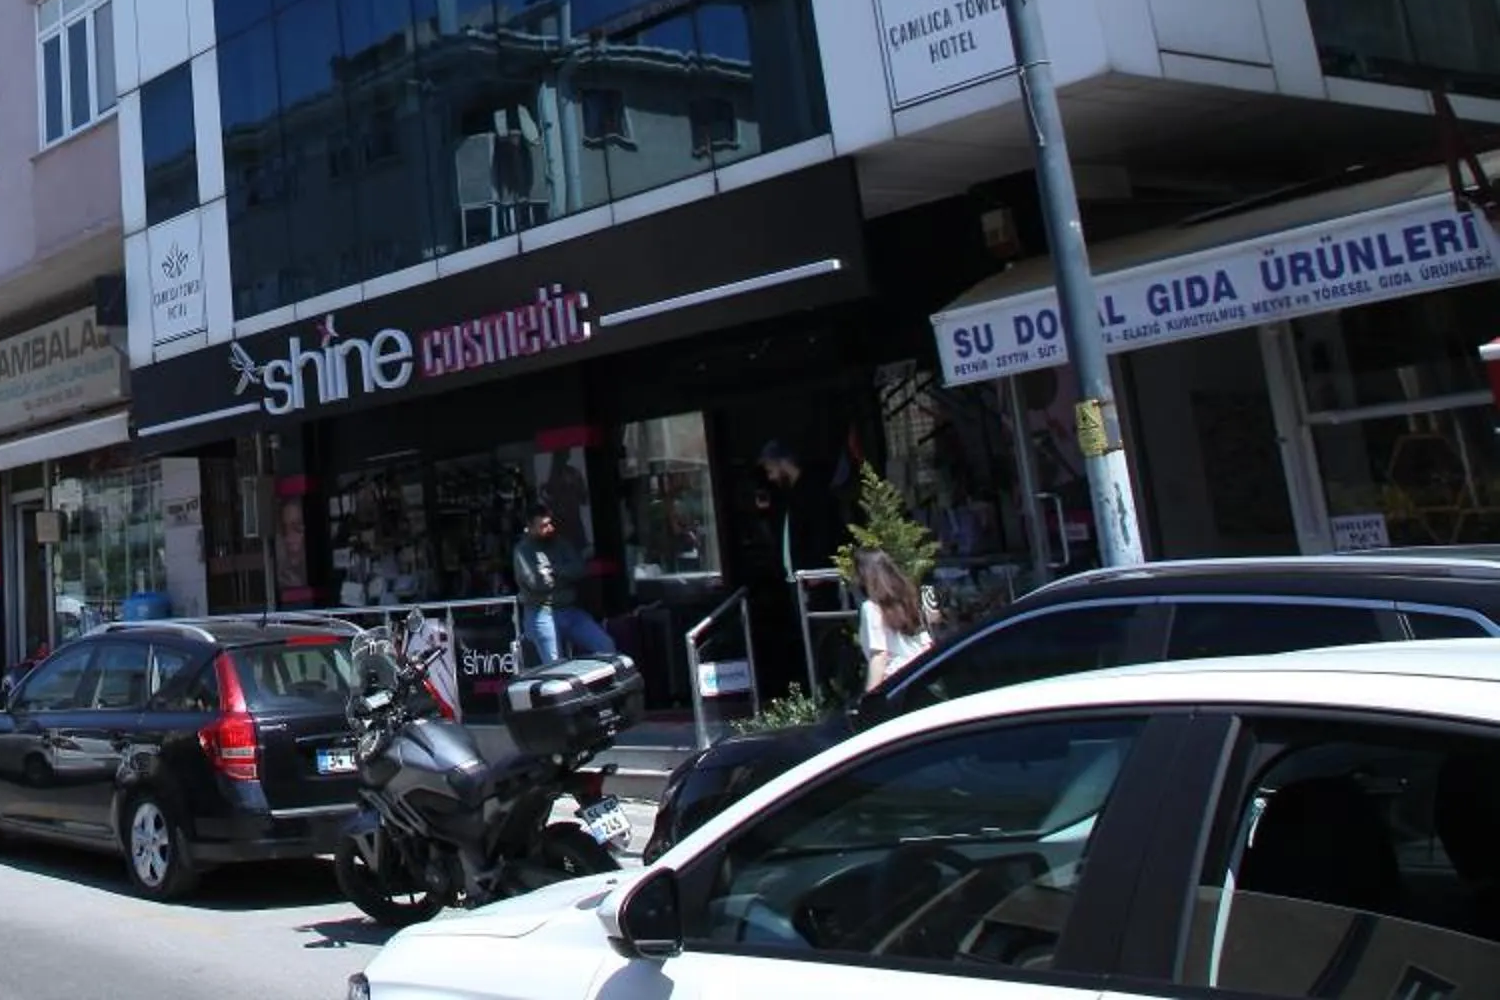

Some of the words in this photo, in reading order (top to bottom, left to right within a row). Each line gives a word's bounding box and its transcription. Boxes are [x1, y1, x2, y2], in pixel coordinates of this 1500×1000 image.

[889, 7, 953, 51] ÇAMLICA
[929, 29, 978, 64] HOTEL
[953, 323, 995, 359] SU
[1013, 295, 1126, 346] DOL
[1146, 269, 1238, 318] GIDA
[1260, 212, 1480, 292] ÜRÜNLERİ
[1313, 279, 1372, 301] YÖRESEL
[1378, 269, 1413, 289] GIDA
[262, 315, 414, 416] shine
[418, 283, 592, 378] cosmetic
[463, 648, 515, 675] shine
